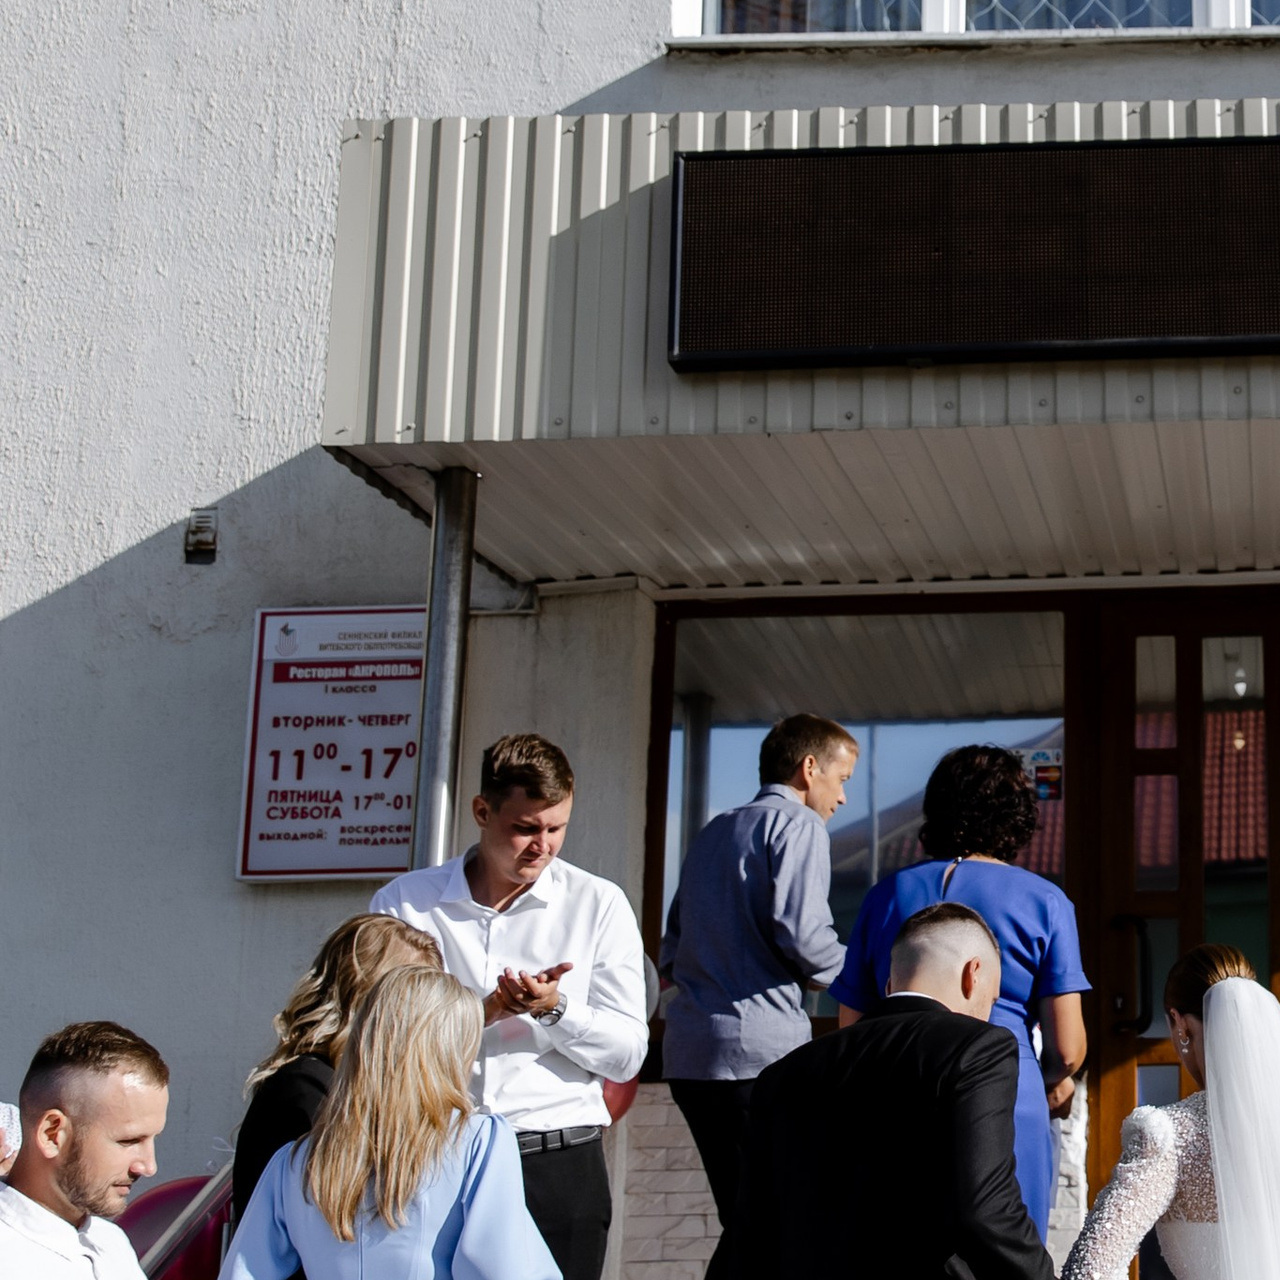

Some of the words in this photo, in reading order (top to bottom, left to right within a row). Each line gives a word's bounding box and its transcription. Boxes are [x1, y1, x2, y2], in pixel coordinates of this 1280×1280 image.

[289, 665, 347, 680] Ресторан
[348, 663, 420, 678] «АКРОПОЛЬ»
[331, 684, 377, 694] класса
[267, 790, 344, 805] ПЯТНИЦА
[266, 806, 342, 821] СУББОТА
[259, 830, 328, 841] выходной:
